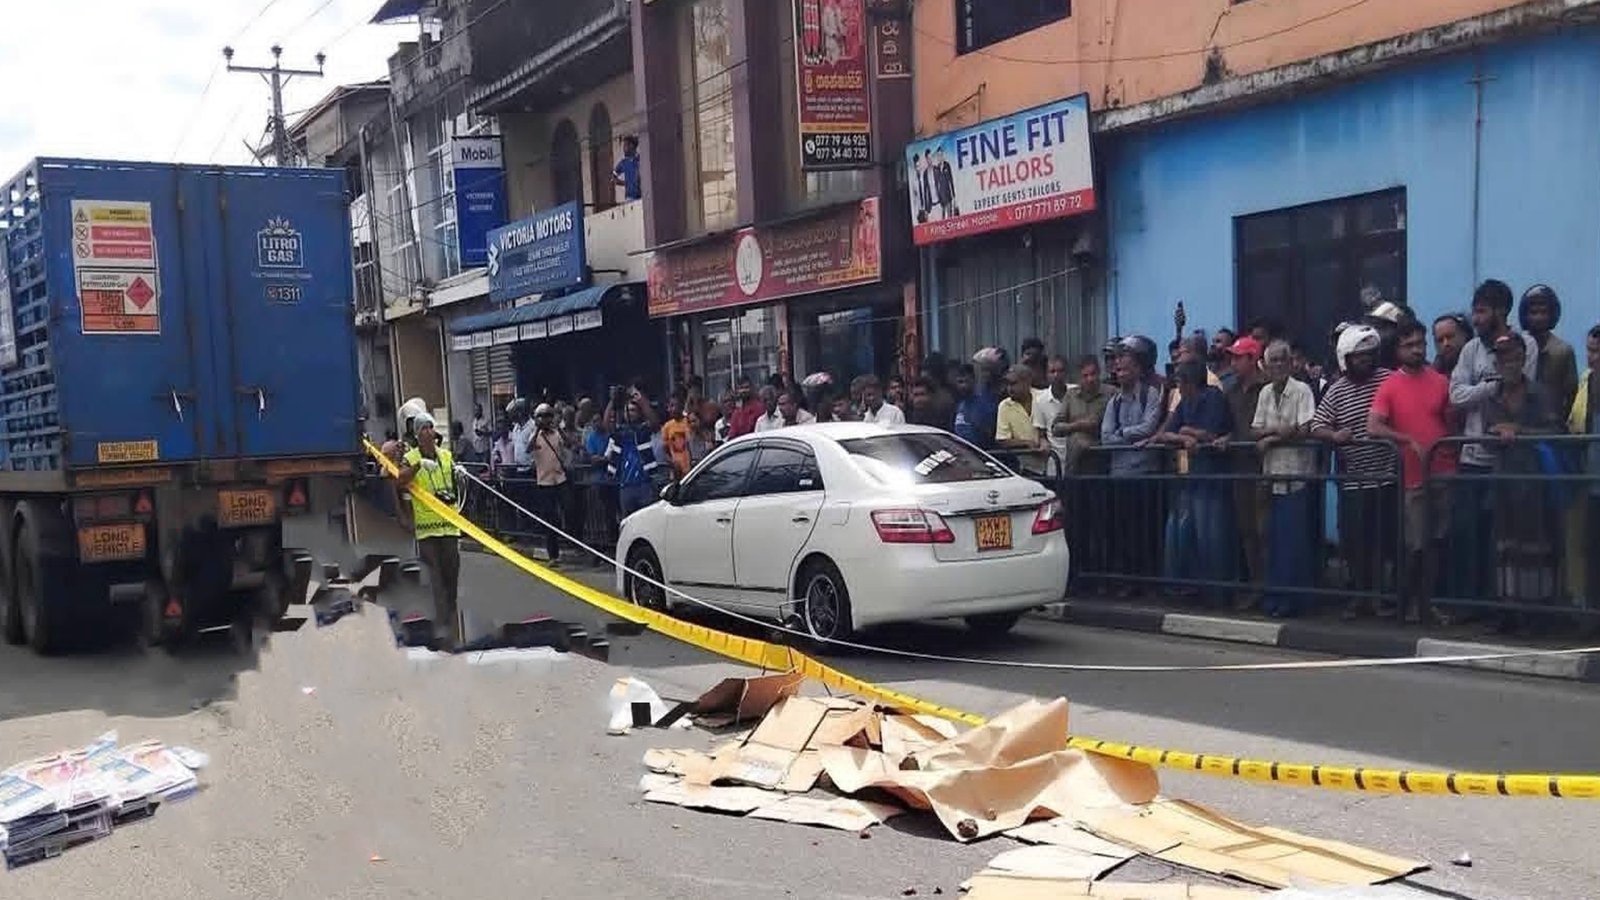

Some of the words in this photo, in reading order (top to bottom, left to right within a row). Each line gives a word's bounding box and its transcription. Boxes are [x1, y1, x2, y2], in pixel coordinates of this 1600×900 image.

[815, 135, 830, 146] 077
[956, 124, 1017, 169] FINE
[1026, 109, 1069, 151] FIT
[461, 147, 493, 160] Mobil
[816, 147, 830, 159] 077
[976, 153, 1054, 191] TAILORS
[974, 196, 1000, 210] EXPERT
[1002, 190, 1026, 204] GENTS
[1028, 181, 1061, 197] TAILORS
[1015, 204, 1032, 220] 077
[500, 221, 535, 252] VICTORIA
[536, 210, 572, 240] MOTORS
[262, 237, 298, 250] LITRO
[268, 249, 294, 262] GAS
[277, 287, 301, 300] 1311
[231, 494, 266, 508] LONG
[93, 528, 129, 543] LONG
